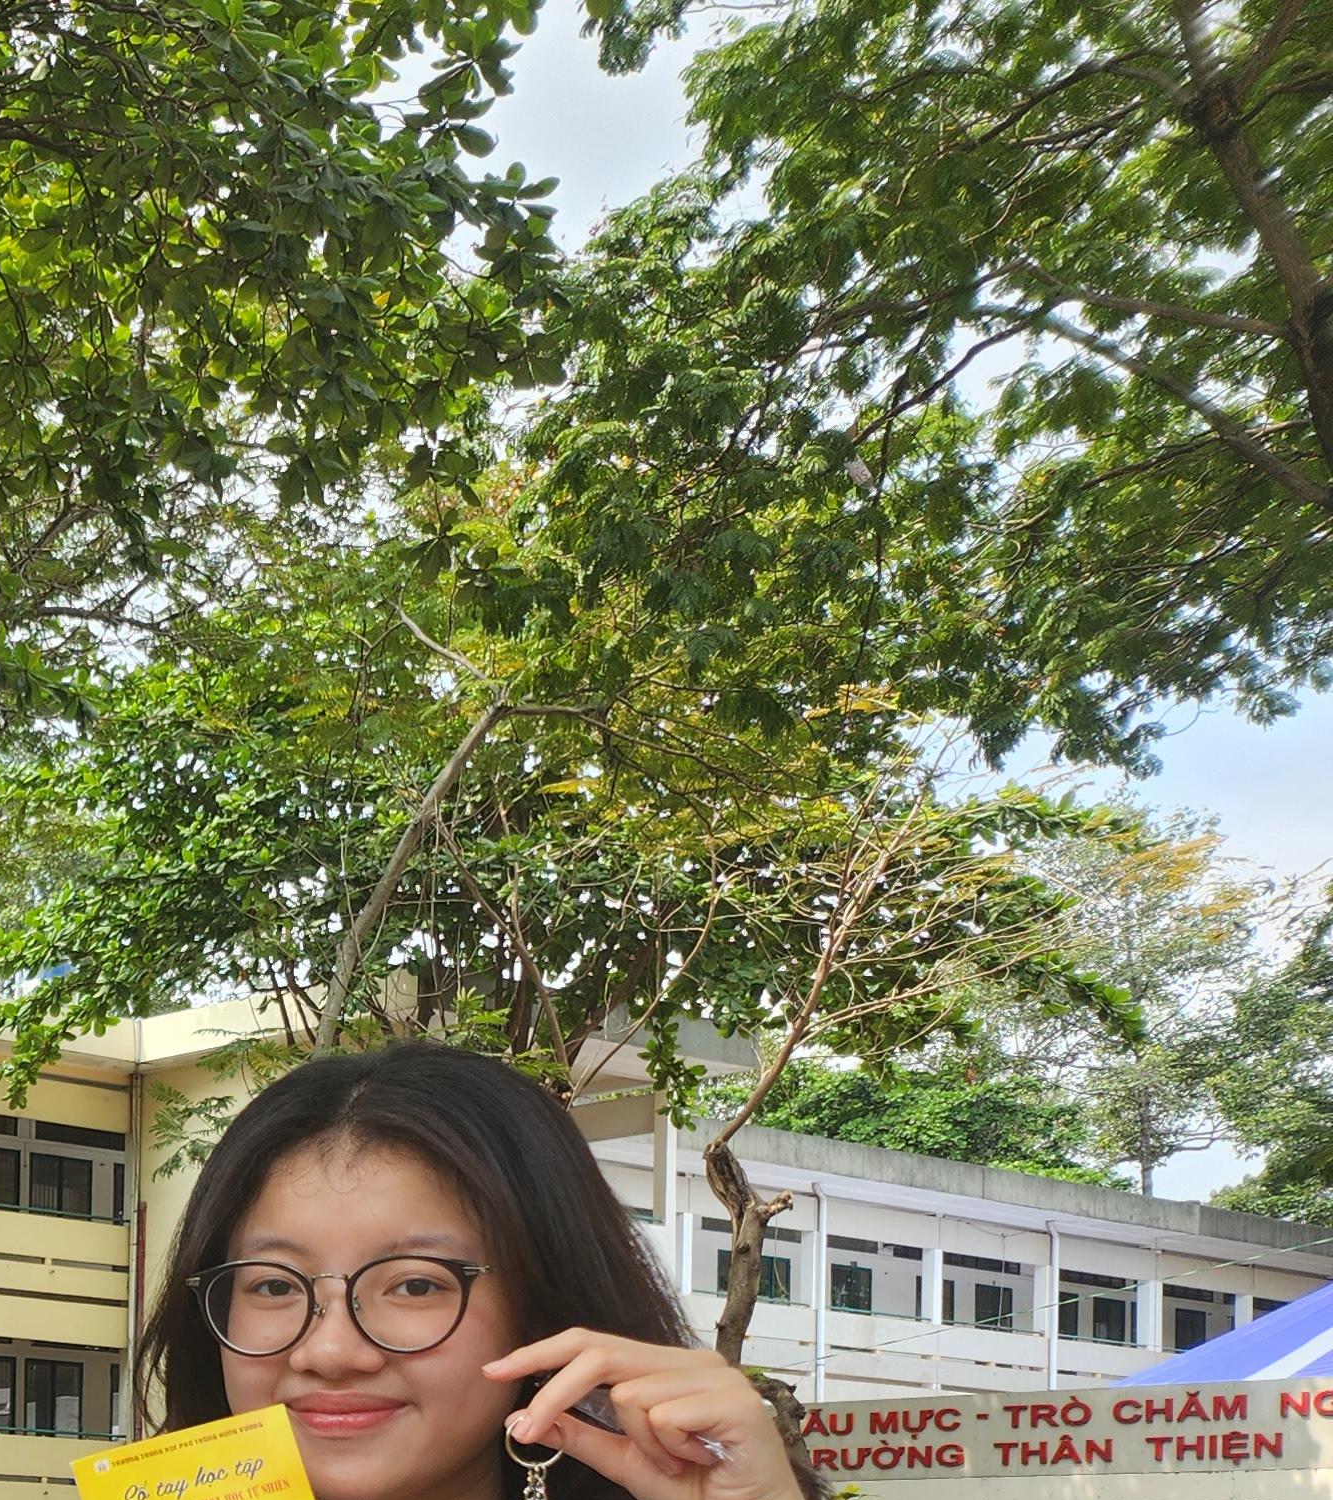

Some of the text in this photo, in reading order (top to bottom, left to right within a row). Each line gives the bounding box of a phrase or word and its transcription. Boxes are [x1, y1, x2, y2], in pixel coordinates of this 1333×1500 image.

[800, 1408, 854, 1437] ẪU
[869, 1408, 962, 1440] MỰC
[1002, 1395, 1093, 1430] TRÒ
[1112, 1391, 1248, 1424] CHĂM
[811, 1431, 1284, 1471] RƯỜNG THÂN THIỆN
[156, 1478, 188, 1500] tay
[194, 1466, 228, 1487] học
[235, 1457, 264, 1481] tập
